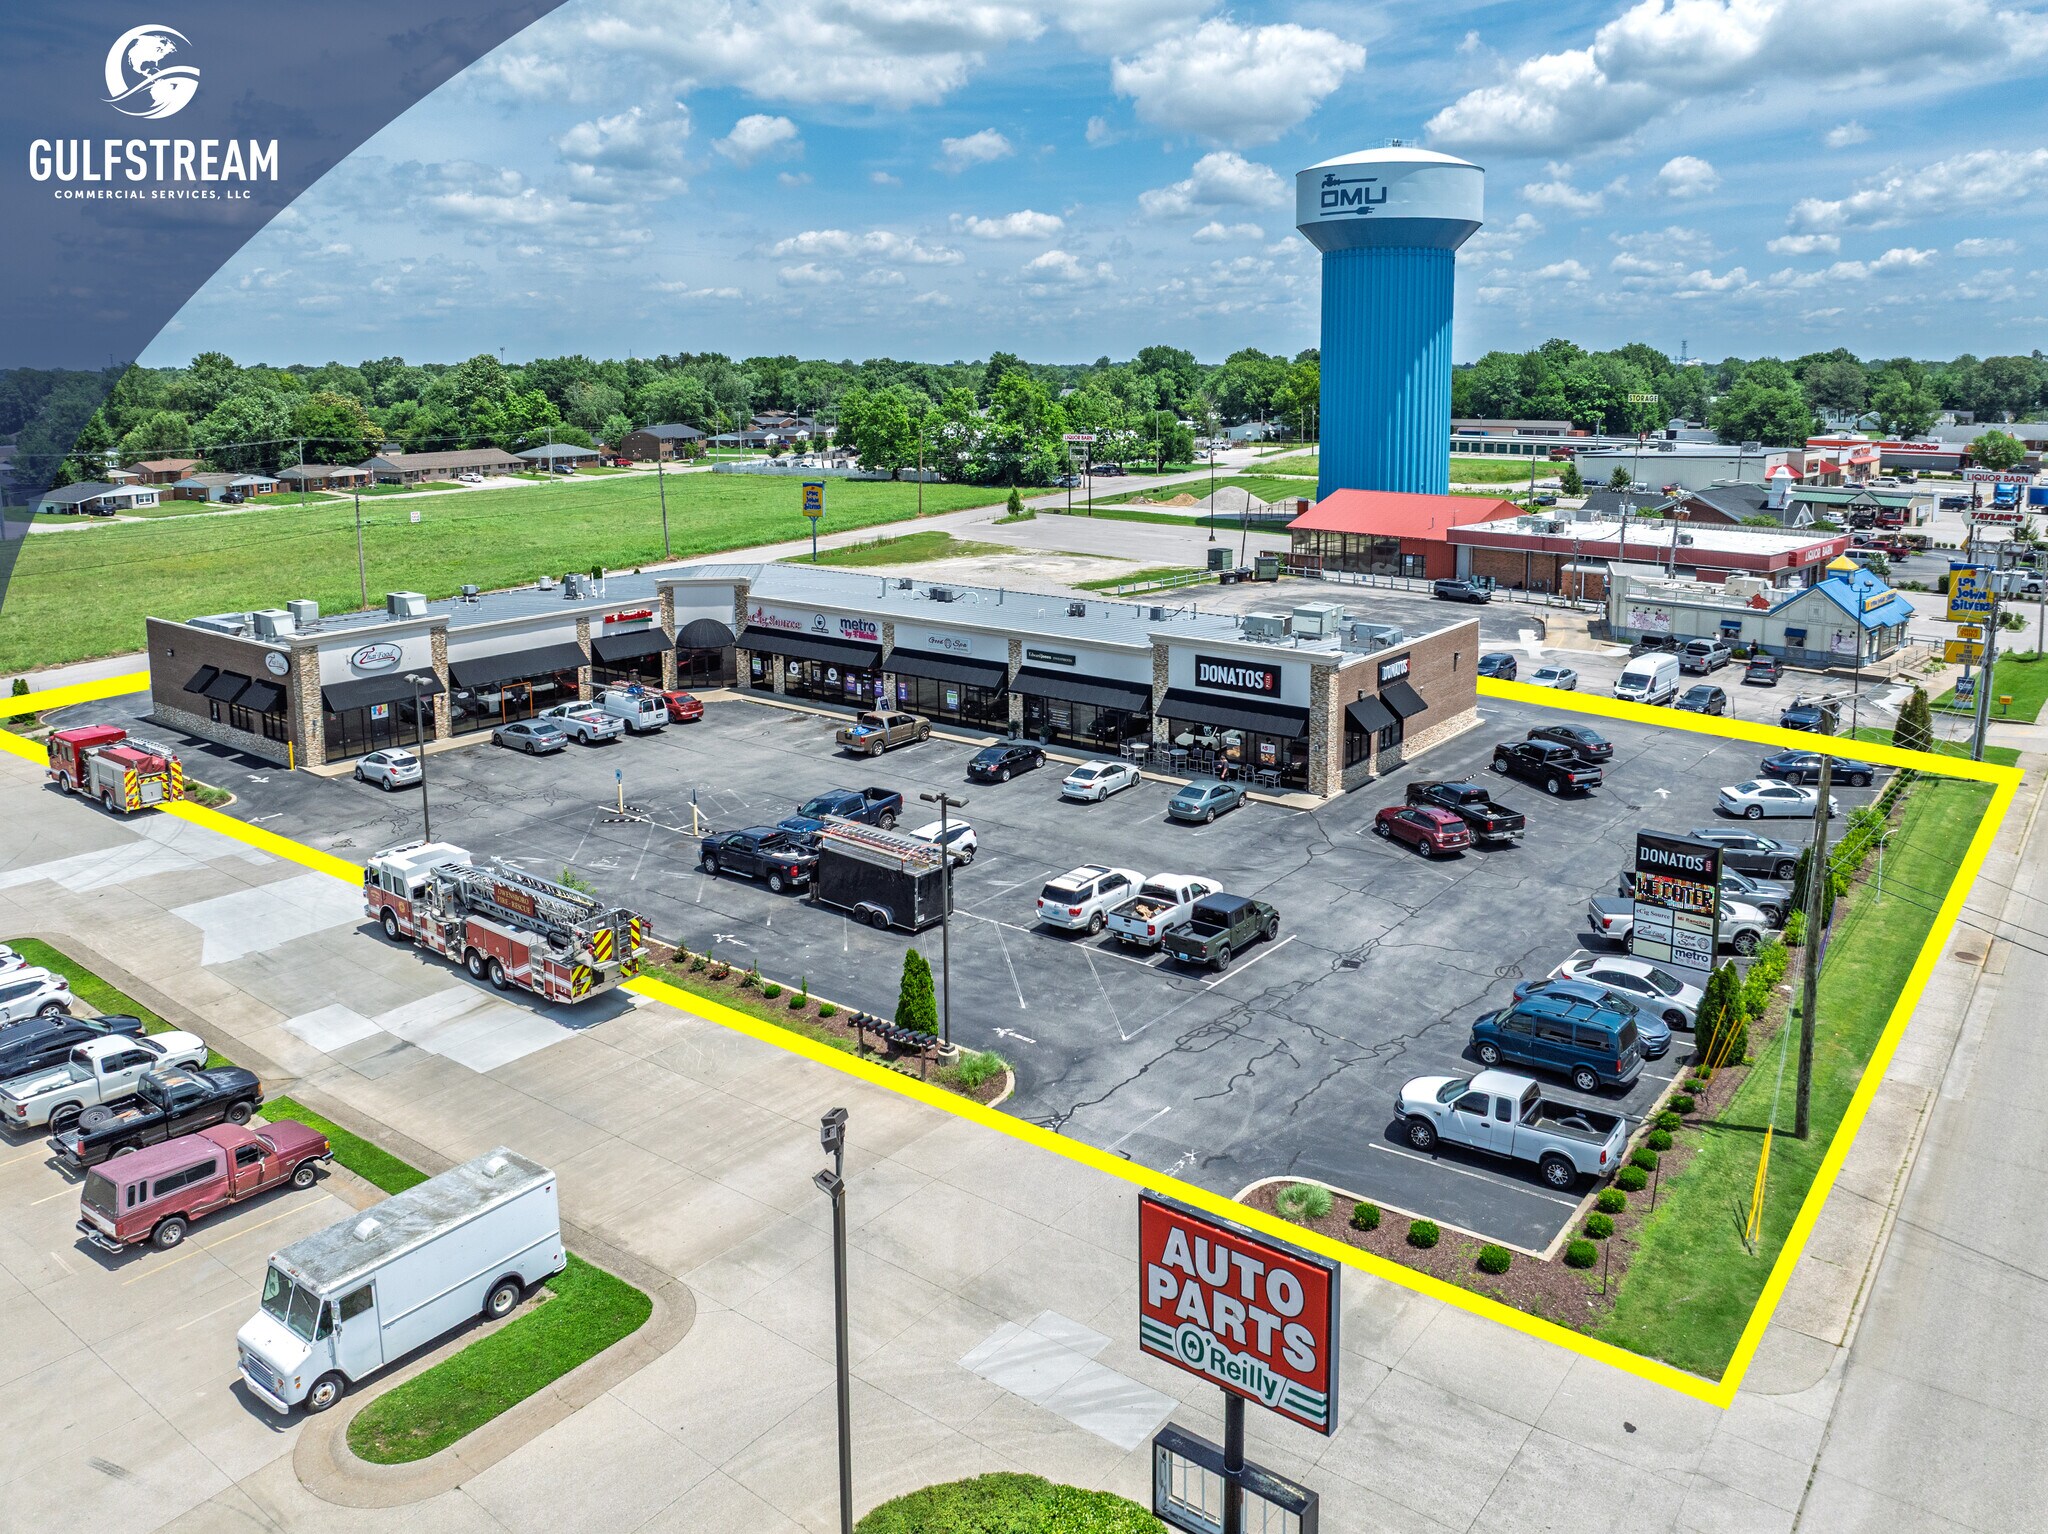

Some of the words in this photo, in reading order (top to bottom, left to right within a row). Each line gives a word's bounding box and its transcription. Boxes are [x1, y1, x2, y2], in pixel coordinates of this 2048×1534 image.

[1321, 186, 1387, 208] OMU
[1628, 394, 1658, 402] STORAGE
[1967, 473, 2001, 482] LIQUOR
[2003, 475, 2029, 483] BARN
[1970, 512, 2024, 522] TAYLOR'S
[840, 618, 876, 633] metro
[1199, 663, 1264, 690] DONATOS
[1381, 659, 1408, 681] DONATOS
[1639, 846, 1704, 872] DONATOS
[497, 888, 529, 905] OWENSBORO
[1662, 883, 1713, 909] CATER
[1650, 911, 1670, 920] Source
[1675, 949, 1709, 963] metro
[1160, 1226, 1305, 1318] AUTO
[1147, 1261, 1317, 1373] PARTS
[1181, 1328, 1278, 1401] O'Reilly
